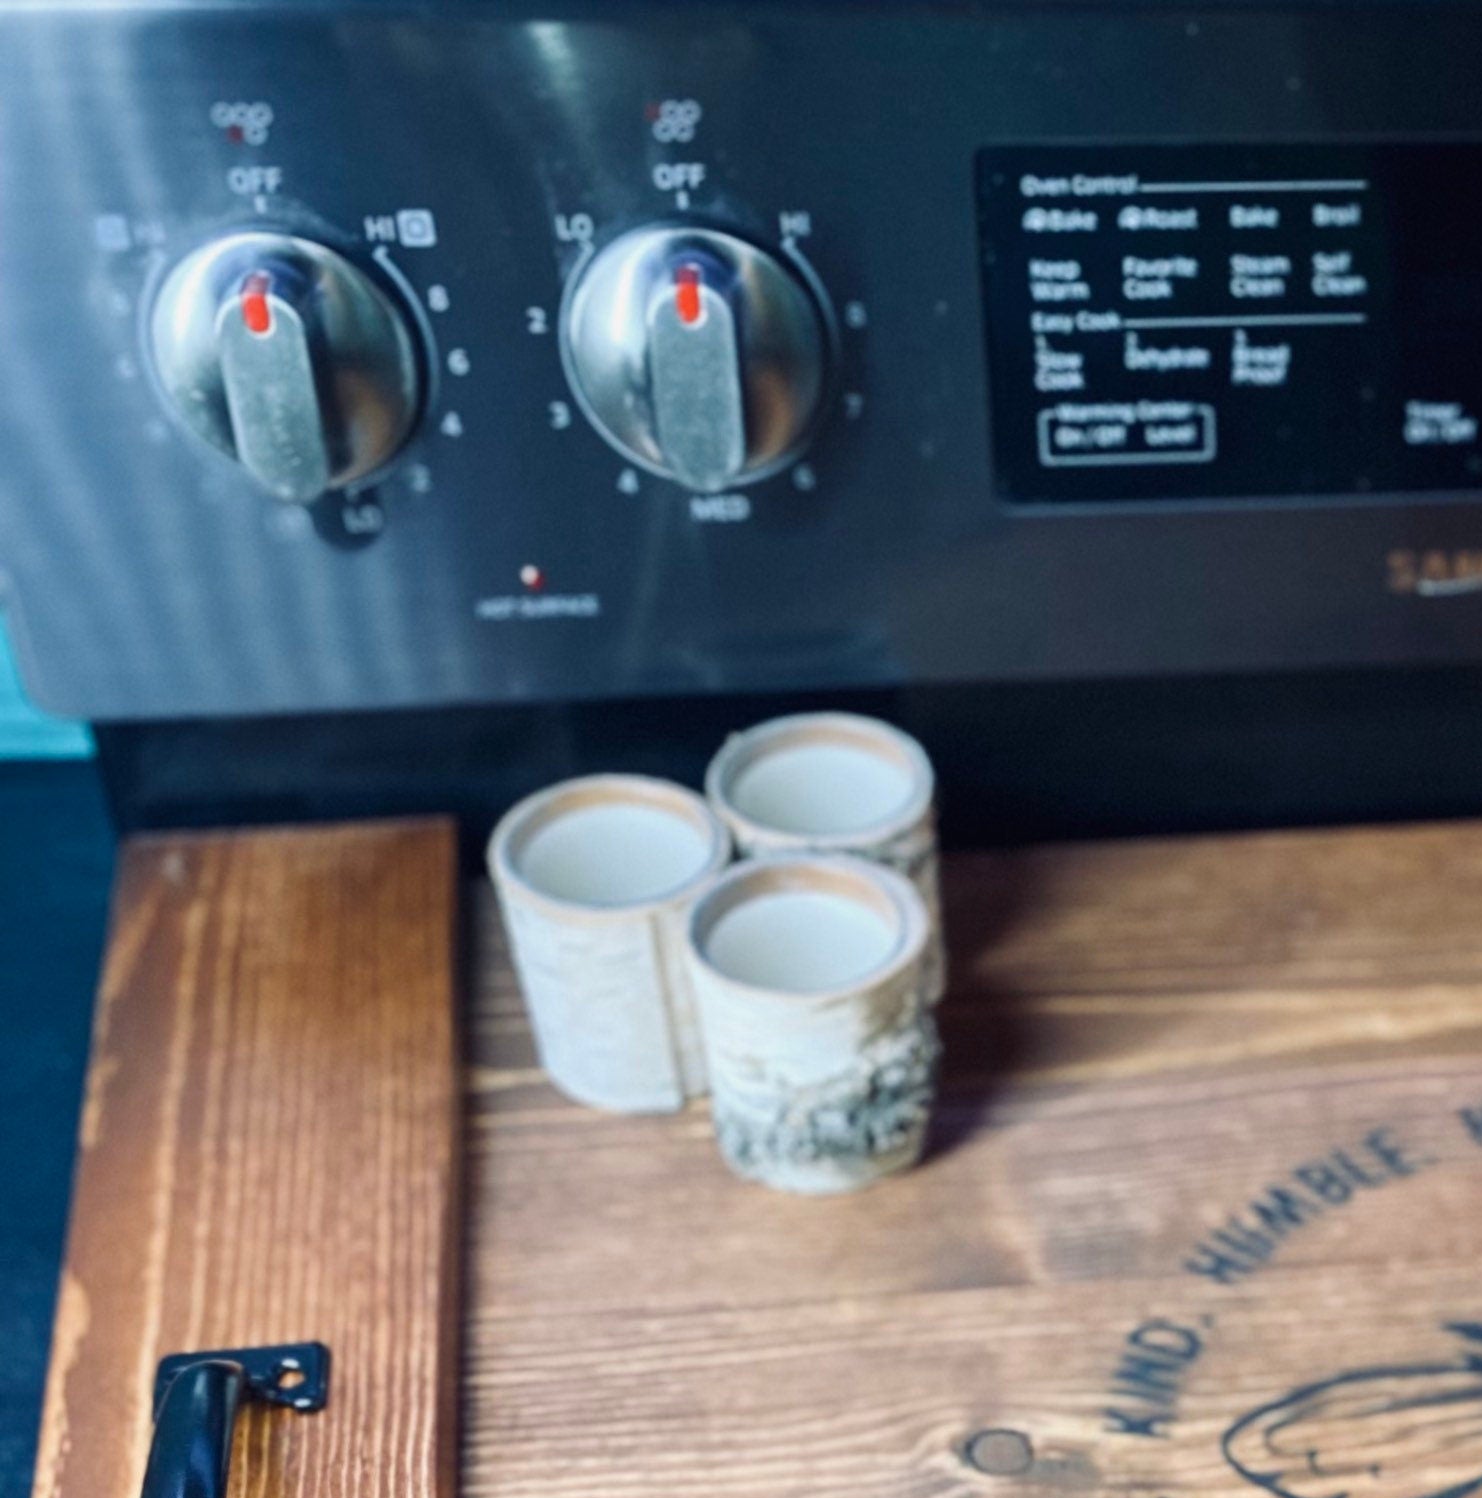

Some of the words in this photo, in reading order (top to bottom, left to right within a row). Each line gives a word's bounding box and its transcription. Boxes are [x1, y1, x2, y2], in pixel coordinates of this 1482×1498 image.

[227, 166, 281, 195] OFF
[652, 163, 705, 190] OFF
[1020, 174, 1069, 197] Oven
[1072, 173, 1139, 197] Control
[364, 215, 396, 242] HI
[554, 213, 595, 242] LO
[779, 210, 811, 236] HI
[526, 305, 549, 335] 2
[447, 349, 470, 377] 6
[440, 411, 463, 438] 4
[549, 401, 571, 431] 3
[616, 468, 640, 496] 4
[689, 495, 751, 523] MED
